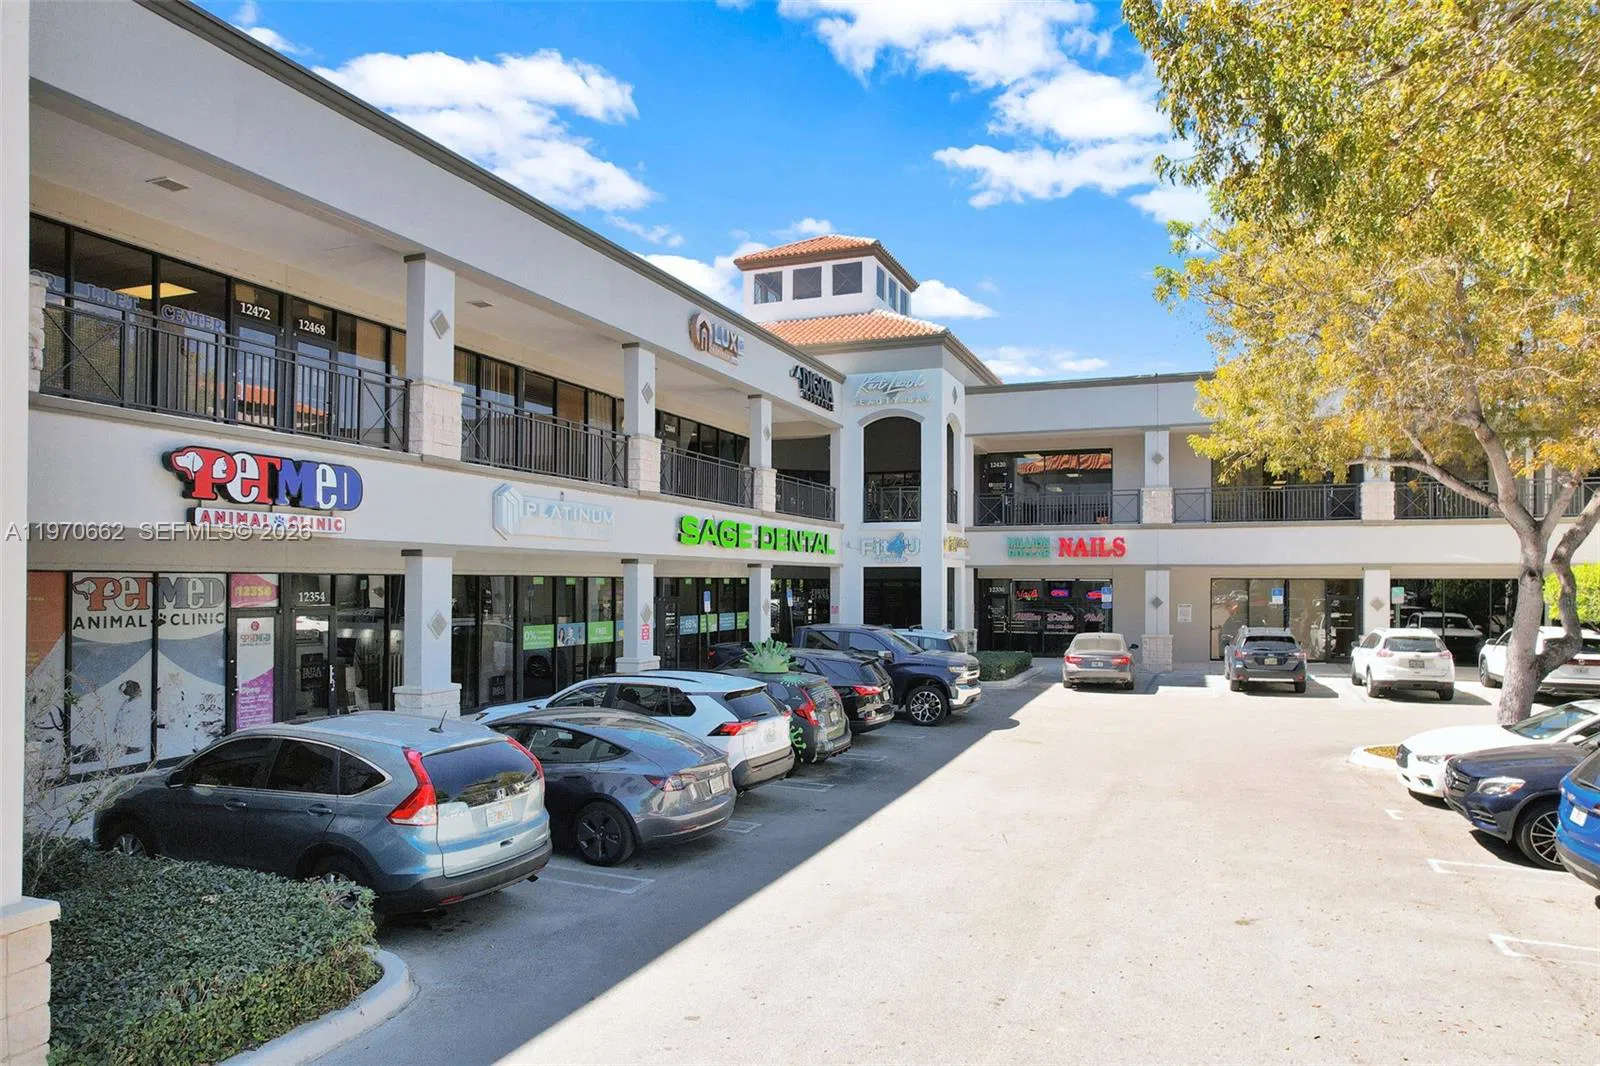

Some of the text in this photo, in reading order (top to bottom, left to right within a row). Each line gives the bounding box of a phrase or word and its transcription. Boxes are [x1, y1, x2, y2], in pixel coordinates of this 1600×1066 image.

[161, 304, 226, 333] CENTER
[240, 302, 270, 320] 12472
[299, 319, 326, 336] 12468
[201, 510, 343, 532] ANIMAL CLINIC
[526, 502, 616, 525] PLATINUM
[678, 514, 836, 555] SAGE DENTAL
[1058, 537, 1126, 557] NAILS
[298, 591, 326, 602] 12354
[73, 612, 225, 630] ANIMAL CLINIC
